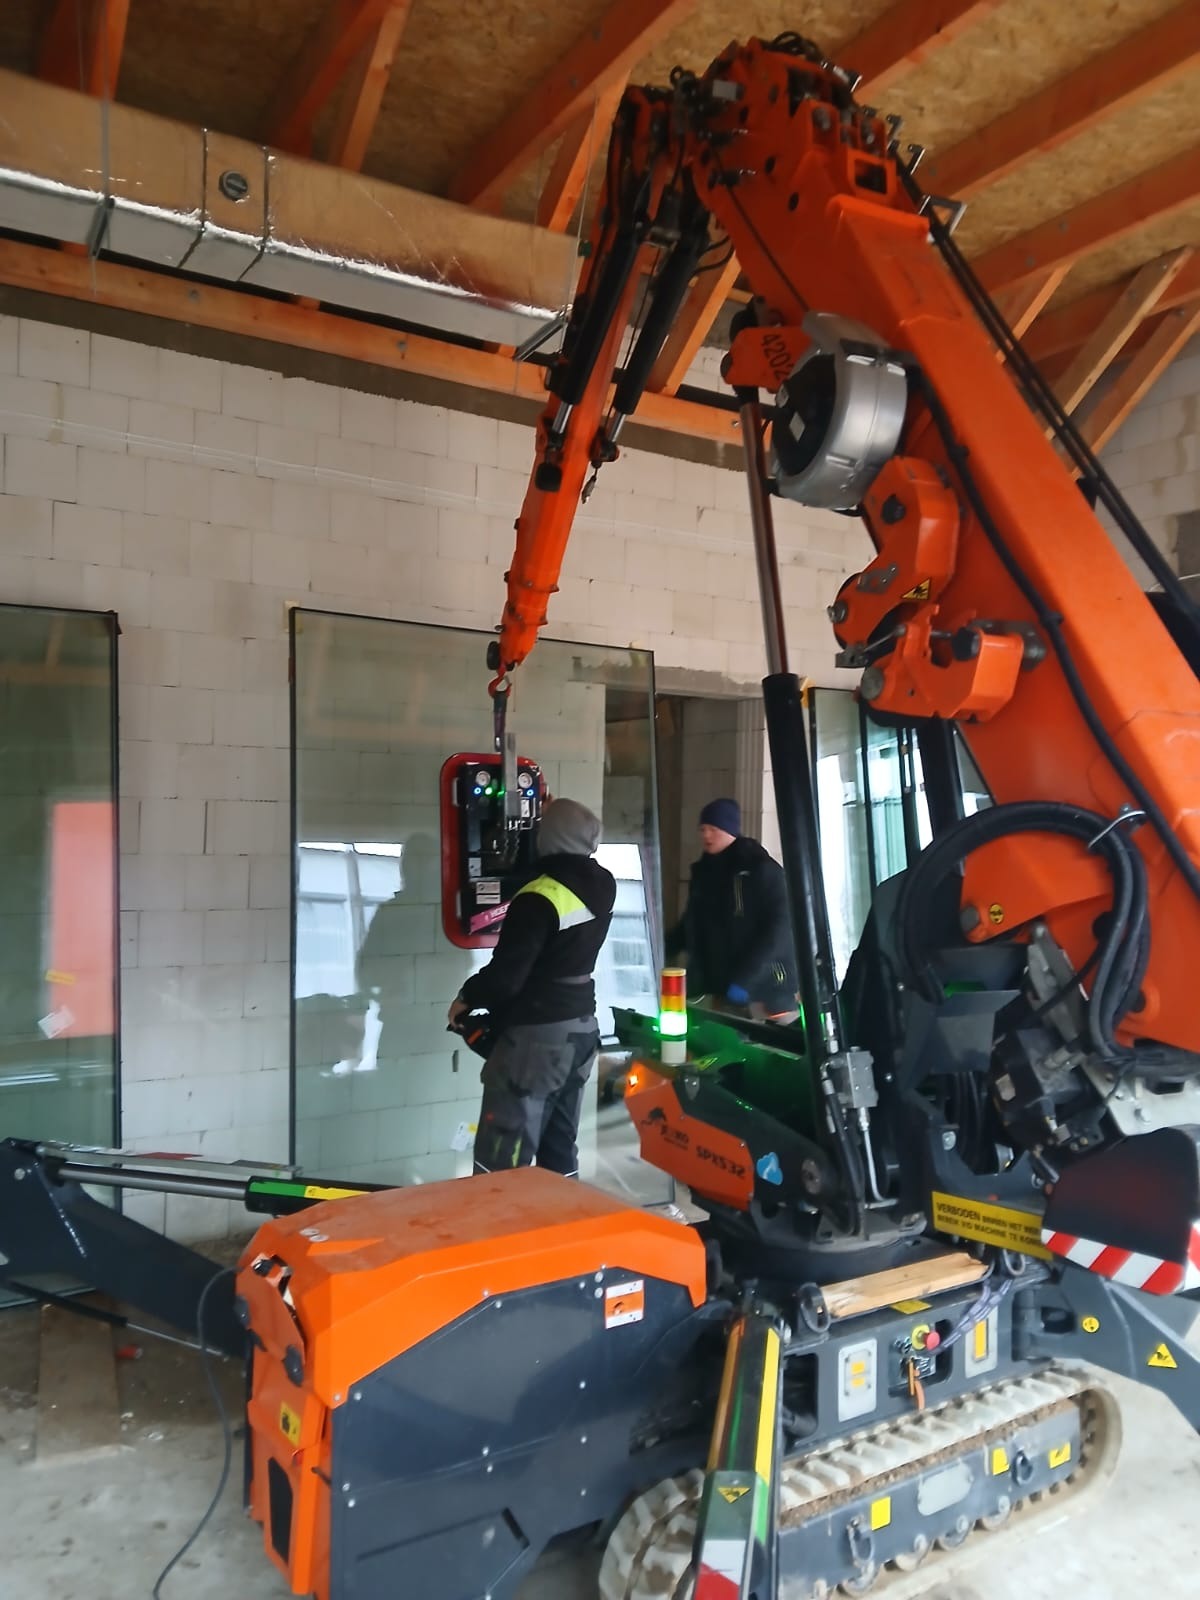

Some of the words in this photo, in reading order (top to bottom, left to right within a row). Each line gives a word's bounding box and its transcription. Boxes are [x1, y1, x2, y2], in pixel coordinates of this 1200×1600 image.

[936, 1202, 981, 1221] VERBODEN
[974, 1222, 1007, 1239] MACHINE
[1008, 1231, 1018, 1241] TE
